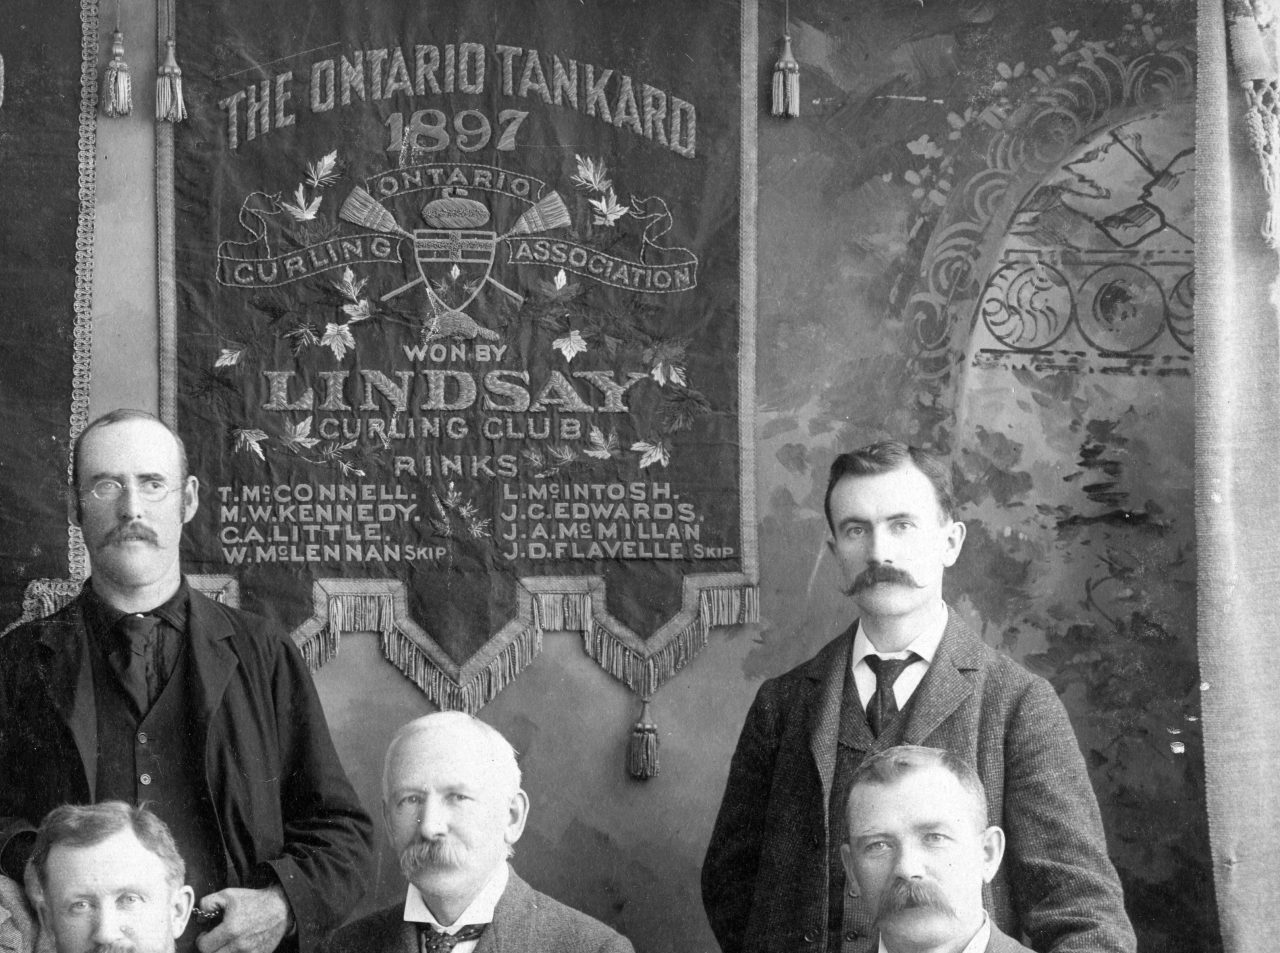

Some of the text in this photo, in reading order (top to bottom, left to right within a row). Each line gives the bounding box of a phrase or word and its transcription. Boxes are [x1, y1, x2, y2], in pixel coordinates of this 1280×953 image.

[218, 43, 697, 160] THE ONTARIO TANKARD
[384, 108, 530, 152] 1897
[378, 166, 531, 197] ONTARIO
[233, 236, 691, 290] CURLING ASSOCIATION
[403, 343, 509, 363] WON BY
[262, 368, 650, 413] LINDSAY
[319, 416, 583, 440] CURLING CLUB
[394, 454, 519, 478] RINKS
